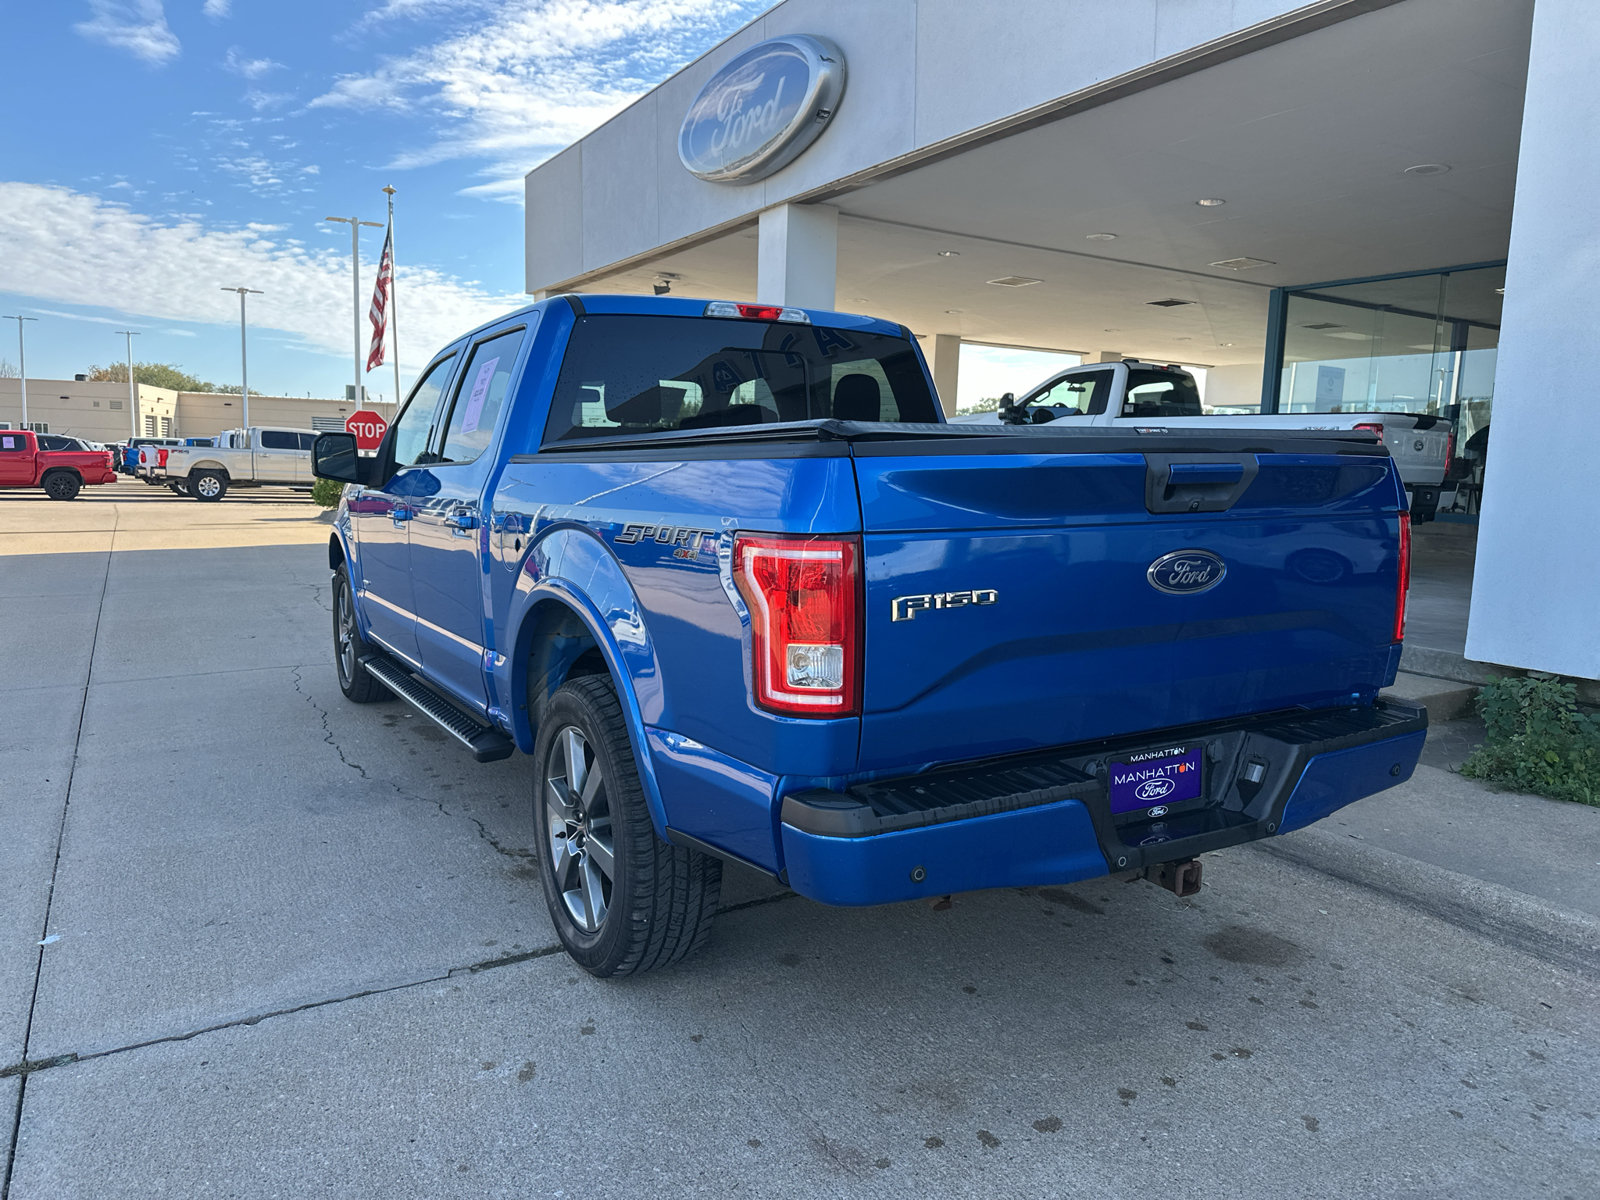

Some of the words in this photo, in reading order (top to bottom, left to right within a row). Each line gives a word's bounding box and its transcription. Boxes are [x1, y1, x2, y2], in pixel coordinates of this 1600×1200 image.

[711, 72, 786, 151] Ford
[348, 422, 386, 439] STOP
[614, 522, 715, 549] SPORT
[1168, 560, 1212, 585] Ford
[1142, 781, 1168, 798] Ford
